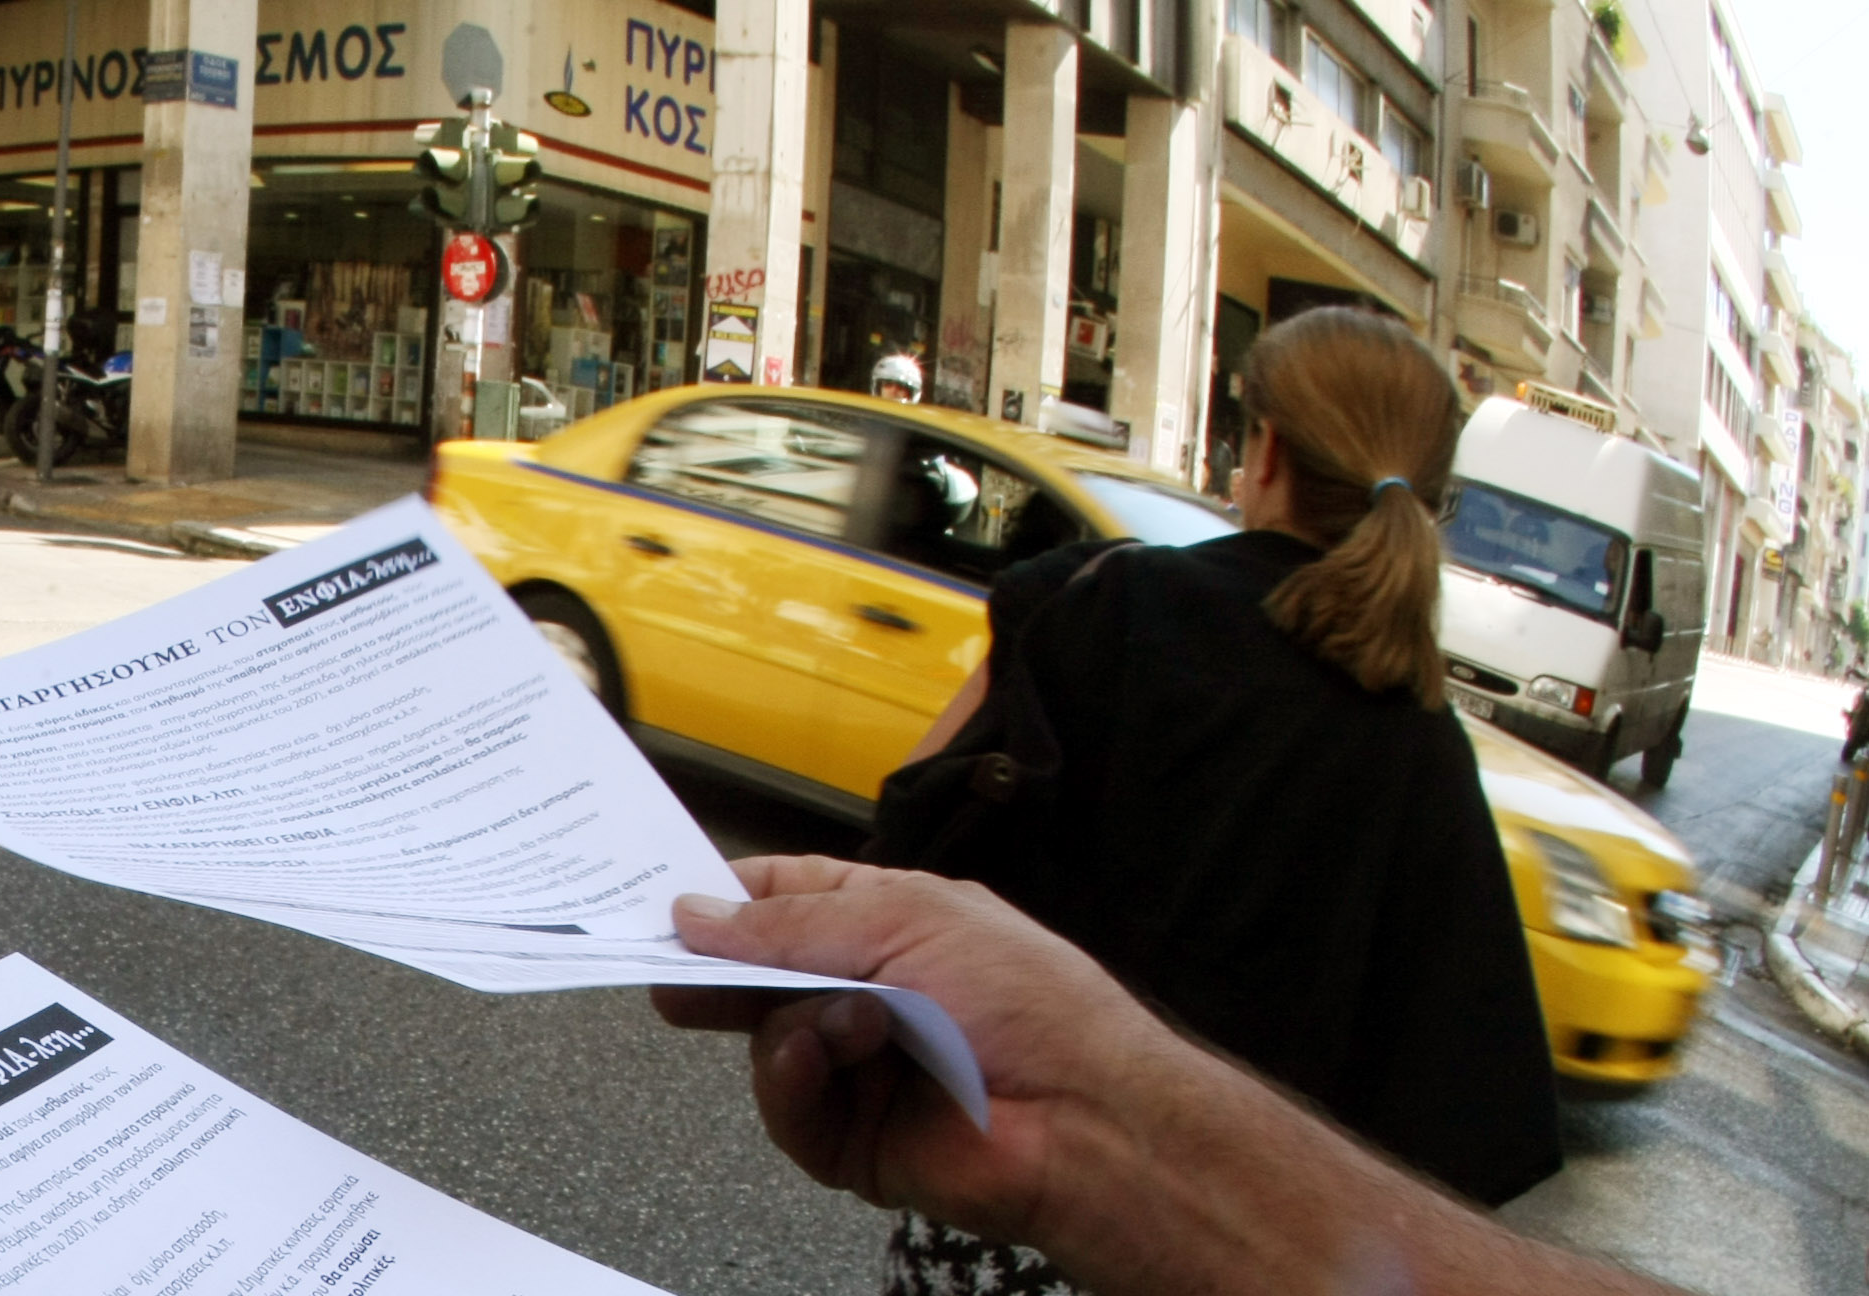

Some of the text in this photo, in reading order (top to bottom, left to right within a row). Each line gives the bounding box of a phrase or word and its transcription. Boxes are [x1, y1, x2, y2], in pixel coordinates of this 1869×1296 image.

[256, 23, 405, 85] ΣΜΟΣ
[626, 17, 715, 94] ΠΥΡΙ
[625, 85, 711, 155] ΚΟΣ
[205, 607, 272, 647] ΤΟΝ
[148, 658, 277, 709] πληθυσμό της υπαίθρου
[10, 1111, 41, 1130] τους
[33, 1081, 94, 1120] μισθωτούς,
[88, 1065, 118, 1083] τους
